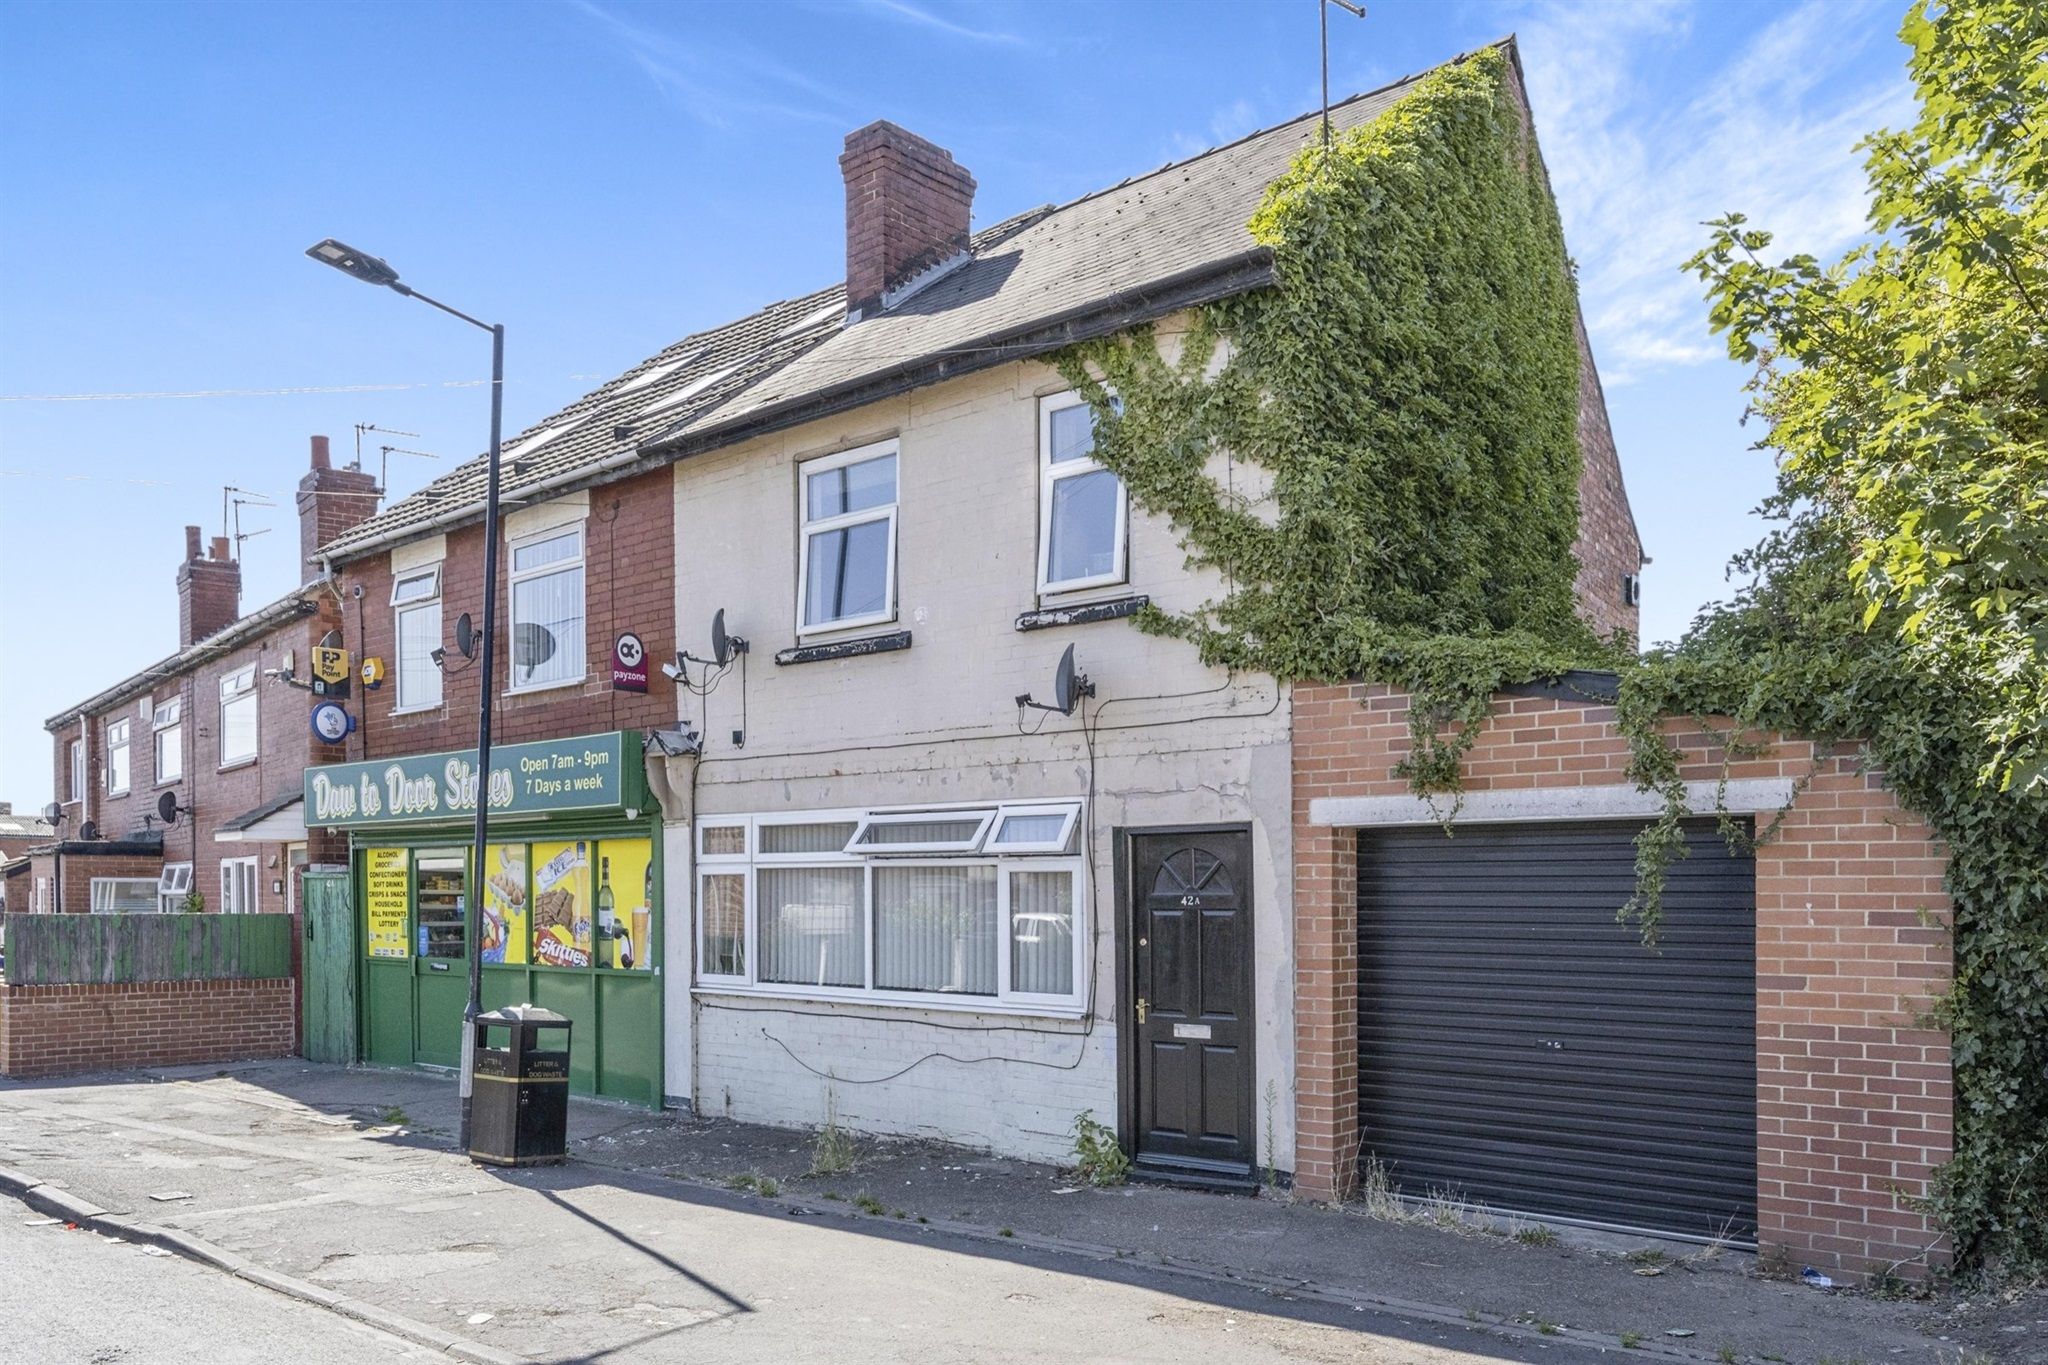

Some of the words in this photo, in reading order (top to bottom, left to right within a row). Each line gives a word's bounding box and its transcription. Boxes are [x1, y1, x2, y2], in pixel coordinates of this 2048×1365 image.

[322, 663, 335, 672] Pay
[322, 669, 341, 678] Point
[613, 671, 647, 682] payzone
[520, 757, 549, 775] Open
[551, 754, 575, 769] 7am
[584, 750, 609, 769] 9pm
[312, 772, 357, 819] Daw
[360, 772, 382, 817] to
[384, 764, 438, 815] Door
[445, 758, 514, 810] Stoes
[526, 780, 532, 795] 7
[535, 778, 562, 796] Days
[564, 780, 571, 791] a
[574, 773, 603, 791] week
[377, 851, 399, 859] ALCOHOL
[1181, 895, 1201, 906] 42A
[371, 910, 382, 918] BILL
[382, 910, 407, 918] PAYMENTS
[378, 920, 399, 928] LOTTERY
[540, 938, 588, 967] Skittles
[528, 1071, 542, 1079] DOG
